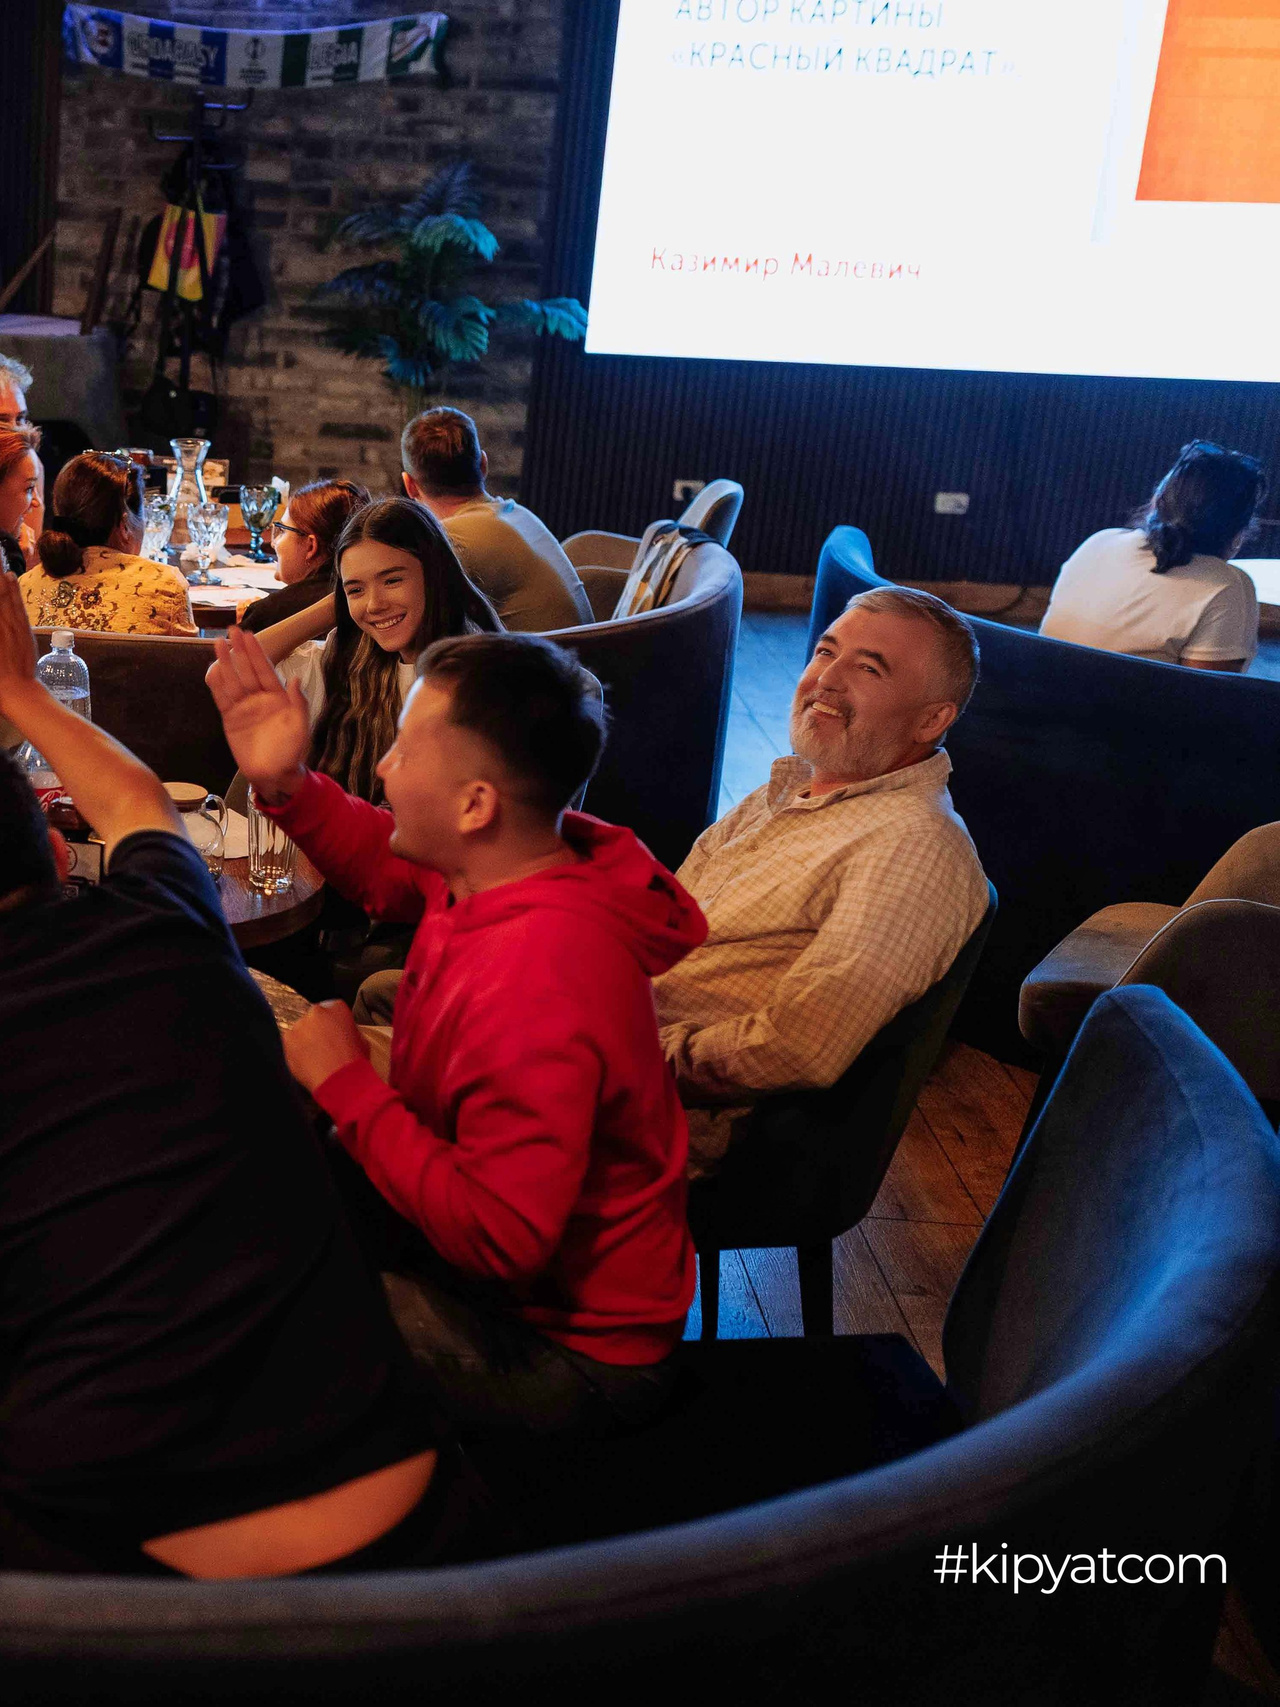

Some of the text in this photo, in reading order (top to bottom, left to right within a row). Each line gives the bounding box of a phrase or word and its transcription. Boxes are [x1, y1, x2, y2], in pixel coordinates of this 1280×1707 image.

[675, 0, 943, 28] АВТОР КАРТИНЫ
[649, 246, 921, 281] Казимир Малевич
